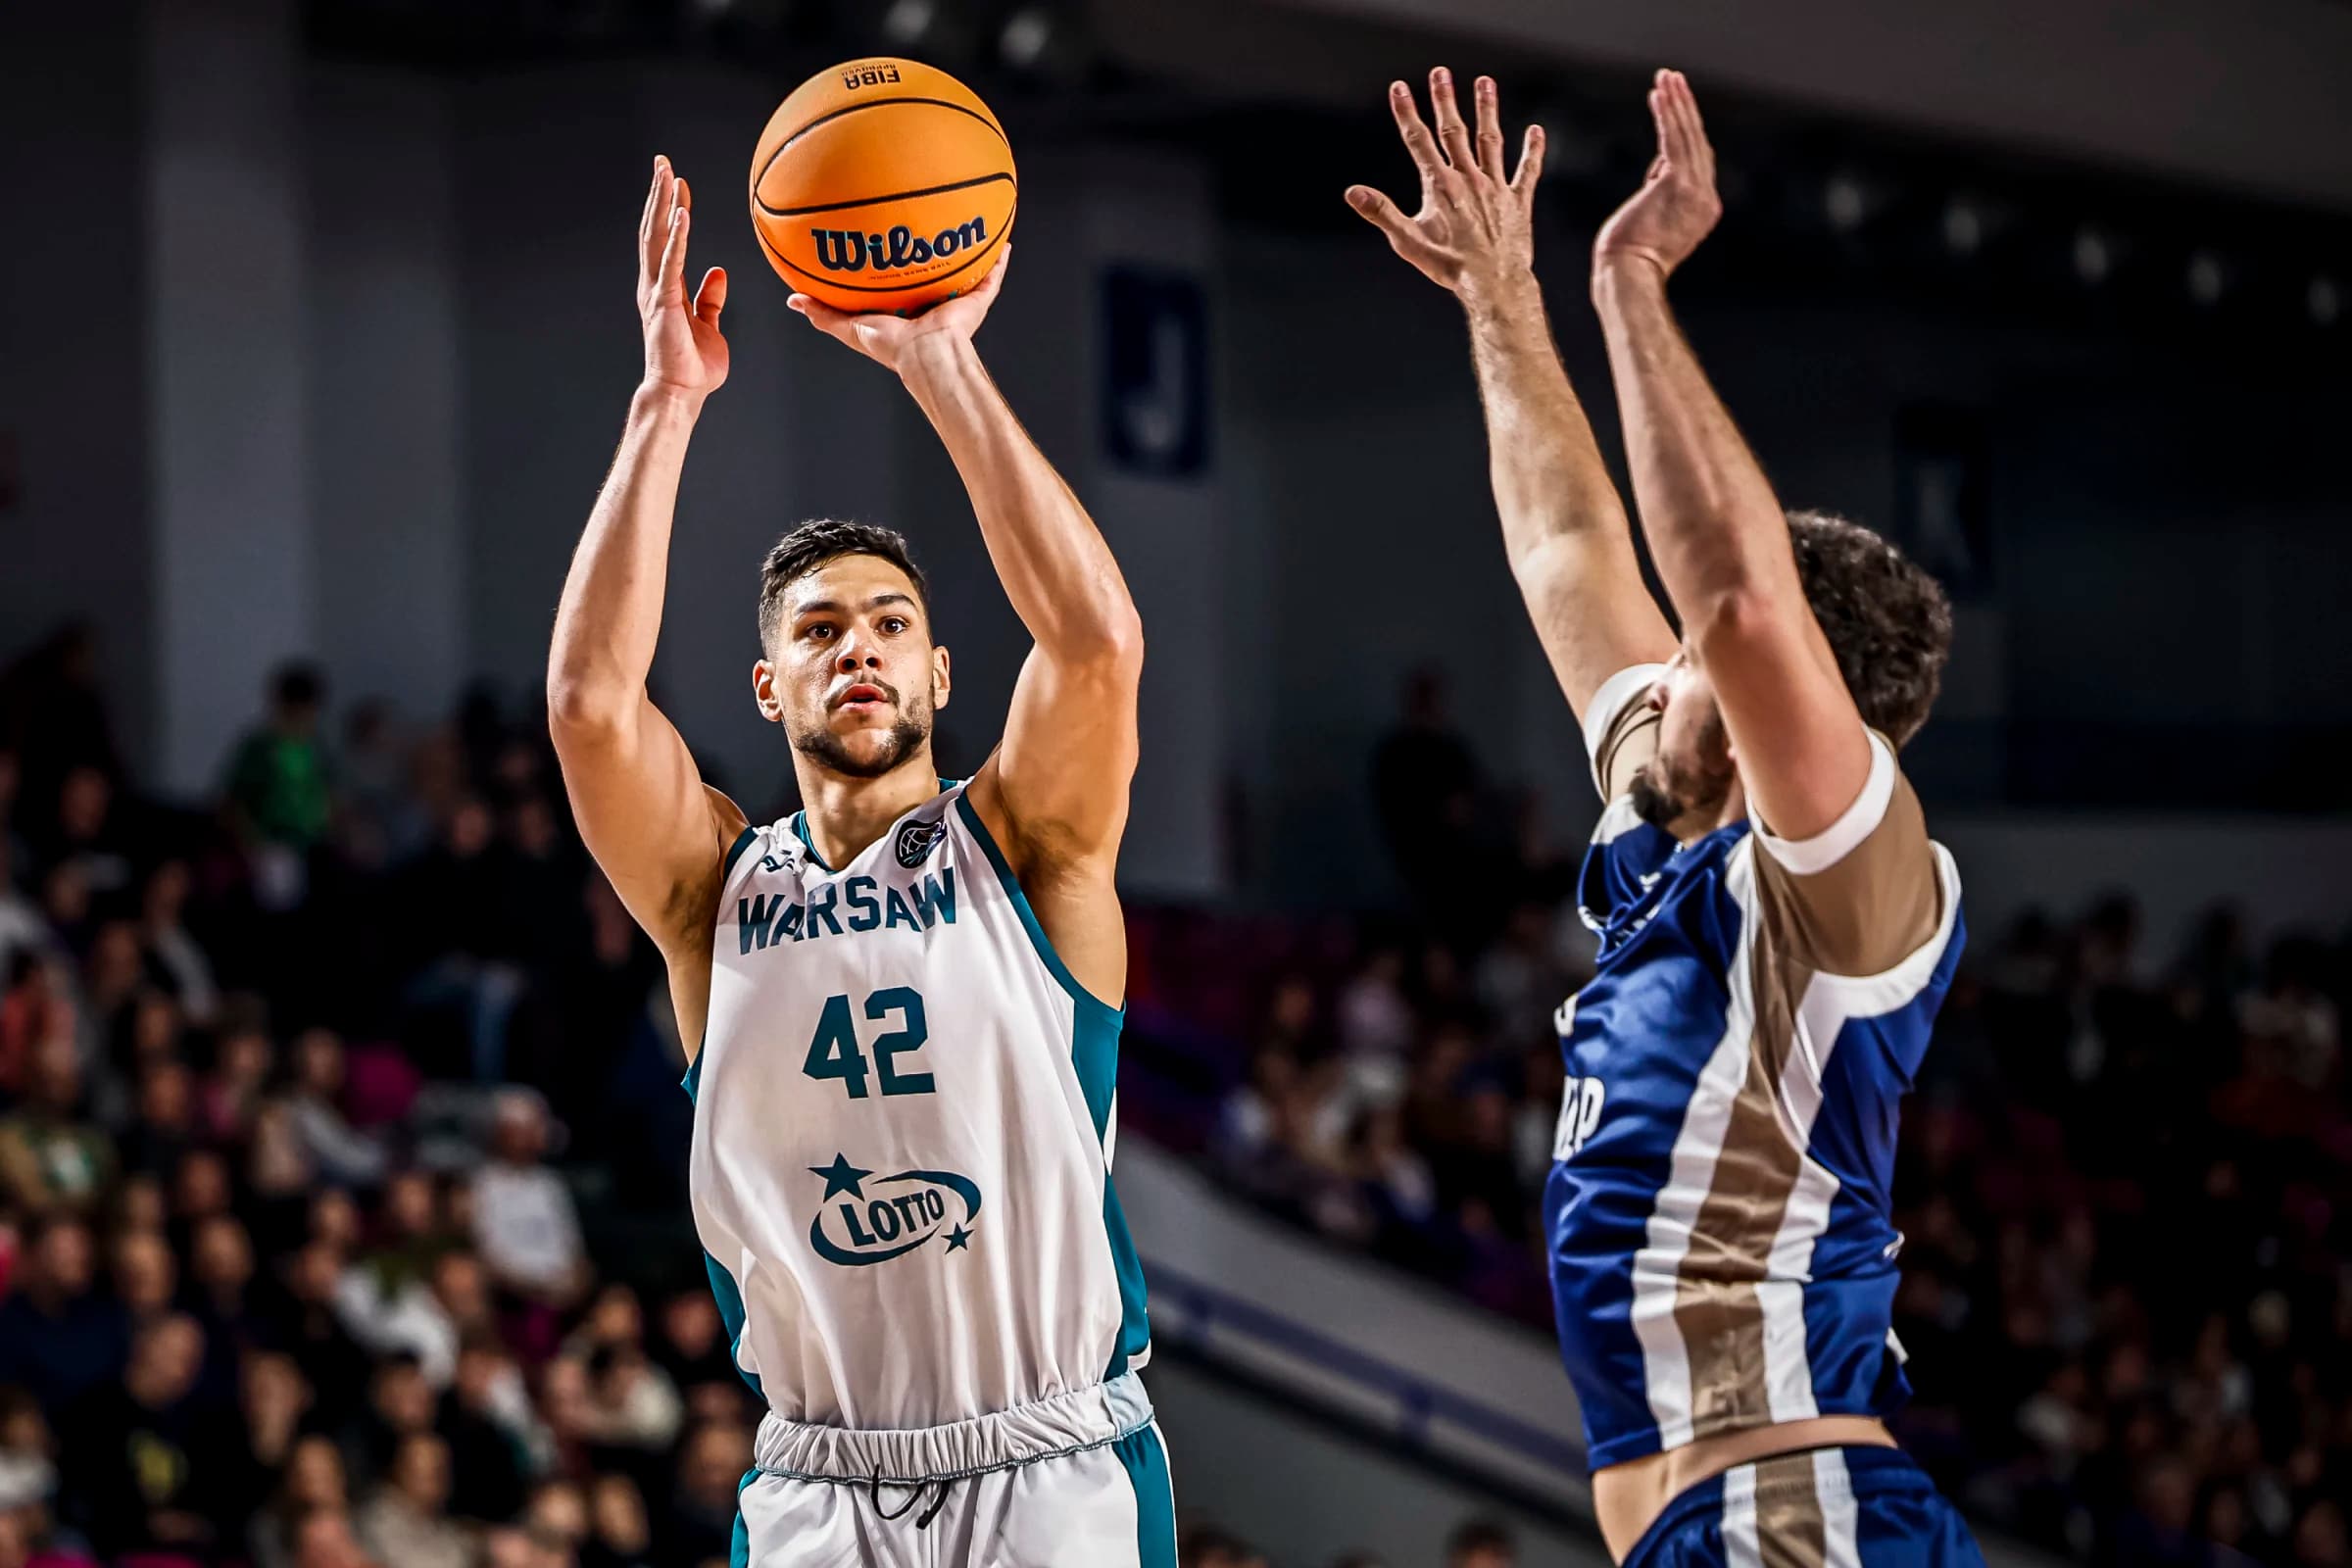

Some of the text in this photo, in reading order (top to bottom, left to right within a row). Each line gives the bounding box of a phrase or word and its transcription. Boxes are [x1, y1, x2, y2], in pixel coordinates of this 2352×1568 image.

[845, 70, 901, 89] FIBA
[810, 217, 987, 271] Wilson
[738, 866, 956, 956] WARSAW
[802, 986, 936, 1099] 42
[839, 1189, 945, 1247] LOTTO
